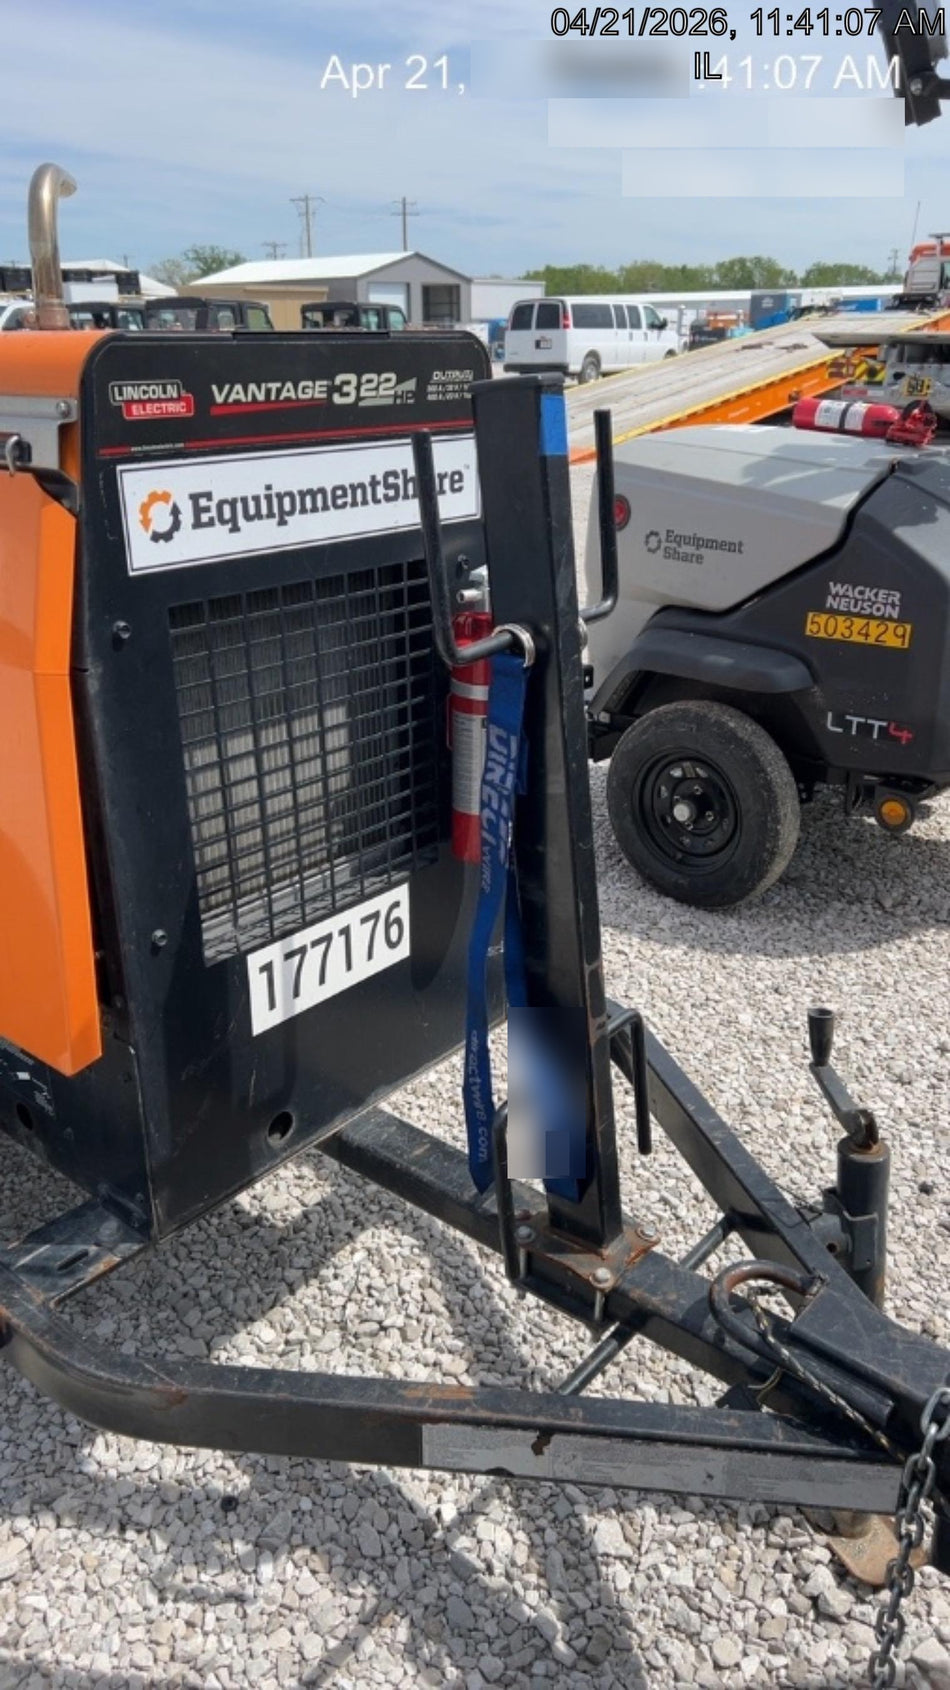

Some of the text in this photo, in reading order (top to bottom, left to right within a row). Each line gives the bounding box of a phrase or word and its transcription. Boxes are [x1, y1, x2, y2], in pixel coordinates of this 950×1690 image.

[113, 383, 181, 402] LINCOLN
[210, 382, 329, 404] VANTAGE
[132, 401, 187, 416] ELECTRIC
[188, 468, 465, 533] EquipmentShre
[664, 529, 744, 554] Equipment
[662, 545, 705, 565] Share
[827, 581, 902, 605] WACKER
[825, 595, 901, 619] NEUSON
[807, 613, 908, 646] 503429
[826, 711, 913, 745] LTT4
[259, 900, 404, 1011] 177176
